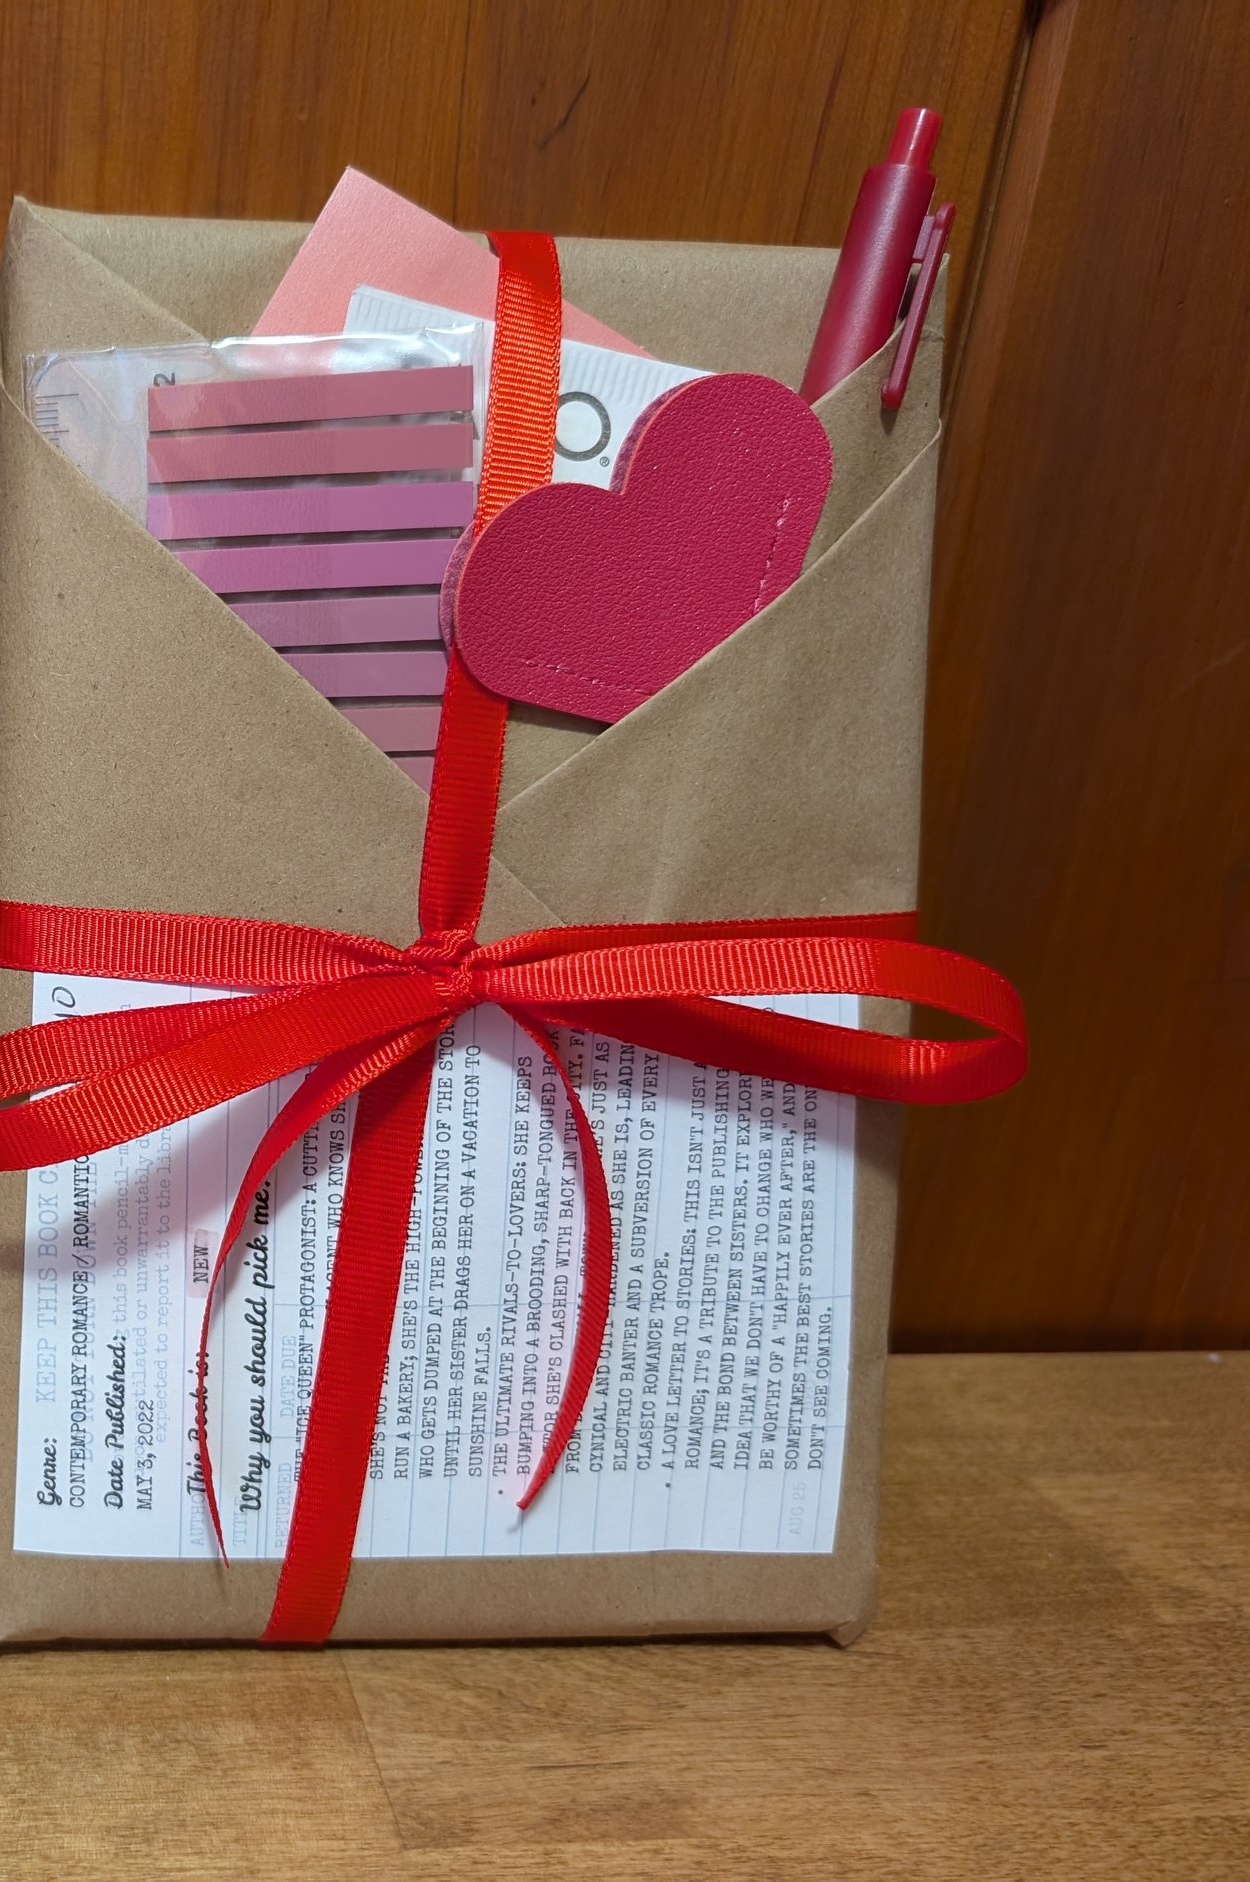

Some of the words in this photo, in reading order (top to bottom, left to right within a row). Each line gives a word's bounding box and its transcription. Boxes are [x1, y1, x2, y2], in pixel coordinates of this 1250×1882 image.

[462, 1043, 481, 1069] TO
[514, 1056, 532, 1114] KEEPS
[641, 1053, 660, 1112] EVERY
[760, 1078, 775, 1102] WE
[782, 1083, 796, 1117] AND
[461, 1075, 479, 1163] VACATION
[513, 1120, 529, 1156] SHE
[639, 1118, 655, 1141] OF
[759, 1106, 774, 1143] WHO
[327, 1130, 345, 1188] KNOWS
[460, 1169, 476, 1180] A
[756, 1149, 772, 1217] CHANGE
[327, 1193, 343, 1230] WHO
[459, 1185, 475, 1209] ON
[630, 1148, 652, 1258] SUBVERSION
[777, 1199, 792, 1245] EVER
[37, 1193, 59, 1258] BOOK
[457, 1214, 473, 1250] HER
[754, 1223, 769, 1246] TO
[192, 1245, 209, 1284] NEW
[240, 1233, 274, 1290] pick
[501, 1162, 526, 1346] RIVALS-TO-LOVERS:
[628, 1264, 644, 1274] A
[751, 1252, 767, 1296] HAVE
[36, 1267, 58, 1329] THIS
[453, 1256, 471, 1311] DRAGS
[626, 1279, 642, 1311] AND
[649, 1252, 669, 1313] TROPE.
[71, 1271, 88, 1356] ROMANCE
[746, 1302, 764, 1349] DON'T
[243, 1297, 267, 1387] should
[449, 1317, 467, 1381] SISTER
[473, 1327, 491, 1385] FALLS.
[619, 1318, 639, 1382] BANTER
[642, 1319, 663, 1395] ROMANCE
[769, 1351, 783, 1374] OF
[771, 1336, 785, 1346] A
[816, 1307, 831, 1379] COMING.
[34, 1338, 57, 1403] KEEP
[743, 1356, 759, 1378] WE
[104, 1336, 126, 1449] Published:
[447, 1386, 463, 1420] HER
[495, 1353, 514, 1437] ULTIMATE
[739, 1383, 757, 1425] THAT
[762, 1379, 781, 1442] WORTHY
[813, 1385, 827, 1418] SEE
[69, 1364, 87, 1508] CONTEMPORARY
[137, 1400, 154, 1446] 2022
[249, 1395, 272, 1444] you
[468, 1392, 487, 1477] SUNSHINE
[612, 1388, 632, 1471] ELECTRIC
[636, 1401, 655, 1471] CLASSIC
[36, 1438, 62, 1506] Genre:
[136, 1453, 156, 1470] 3,
[443, 1426, 460, 1478] UNTIL
[492, 1443, 508, 1477] THE
[733, 1431, 752, 1470] IDEA
[758, 1449, 774, 1470] BE
[807, 1424, 824, 1470] DON'T
[103, 1458, 124, 1509] Date
[136, 1475, 152, 1510] MAY
[239, 1452, 271, 1512] Why
